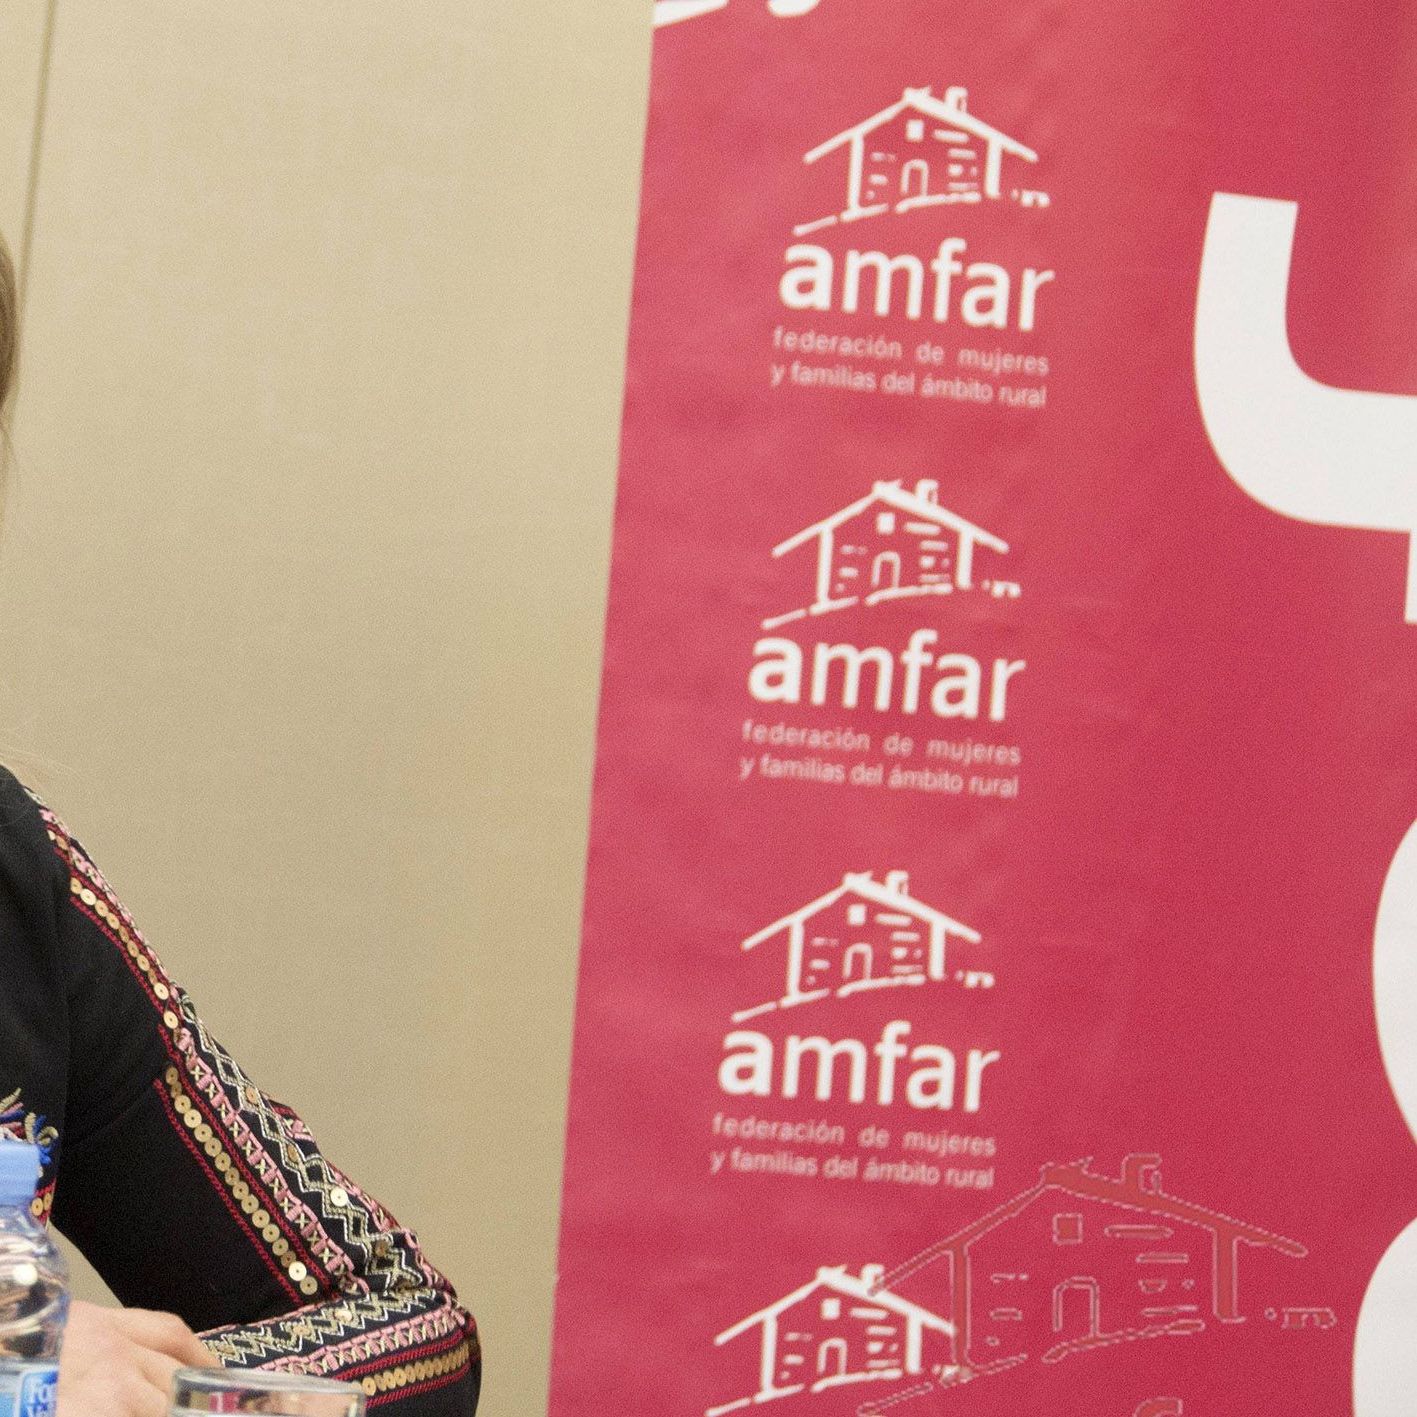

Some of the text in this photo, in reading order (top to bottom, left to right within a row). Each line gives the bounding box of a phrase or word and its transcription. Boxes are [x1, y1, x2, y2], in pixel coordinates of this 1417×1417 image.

[779, 237, 1054, 331] amfar
[774, 326, 1049, 376] federación de mujeres
[771, 361, 1046, 407] y familias del ámbito rural
[748, 628, 1026, 722] amfar
[743, 719, 1021, 767] federación de mujeres
[740, 753, 1019, 798] y familias del ámbito rural
[718, 1020, 1000, 1113] amfar
[713, 1112, 996, 1158] federación de mujeres
[711, 1147, 994, 1189] y familias del ámbito rural
